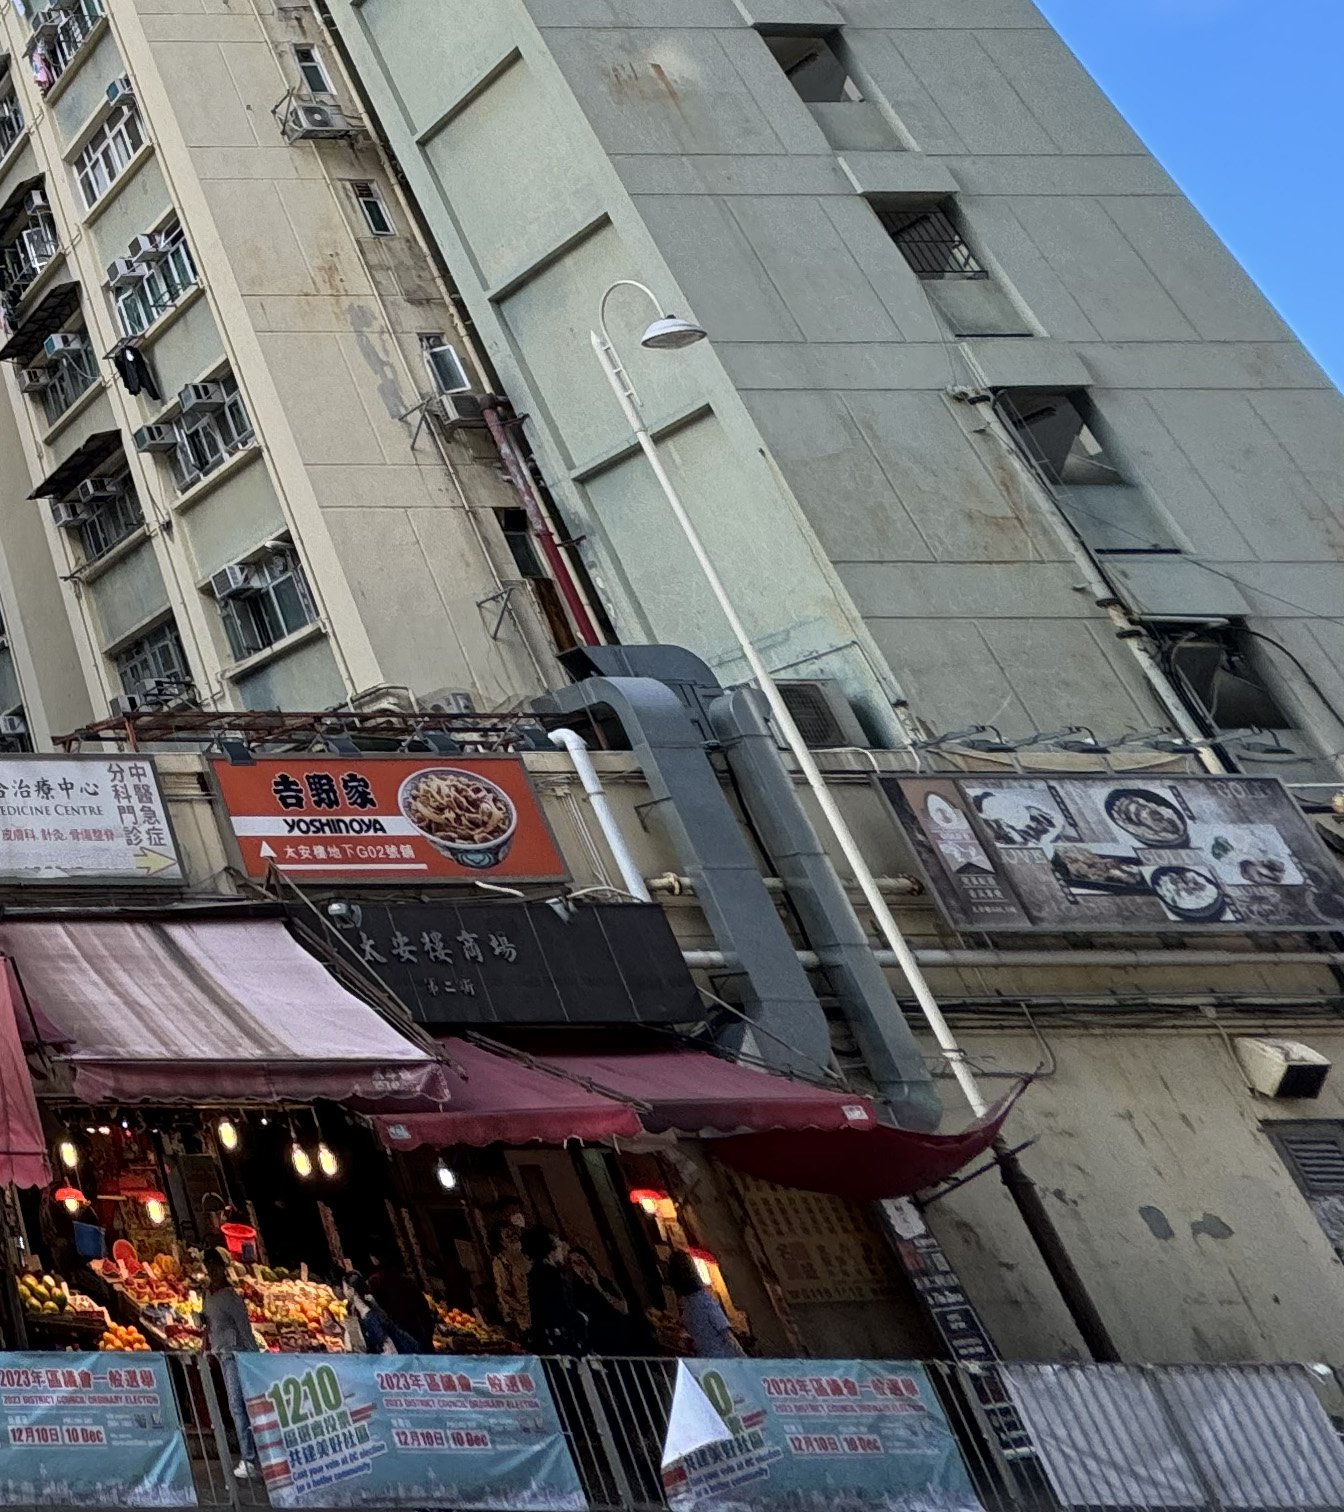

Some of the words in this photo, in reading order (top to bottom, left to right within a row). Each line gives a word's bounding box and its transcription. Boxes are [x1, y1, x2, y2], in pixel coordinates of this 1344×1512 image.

[107, 763, 144, 847] 分科門診
[128, 763, 168, 847] 中醫急症
[283, 818, 388, 834] YOSHINOYA
[267, 1363, 344, 1428] 1210
[10, 1428, 59, 1443] 12月10日
[65, 1428, 79, 1443] 10
[81, 1428, 104, 1443] Dec
[396, 1431, 443, 1446] 12月10日
